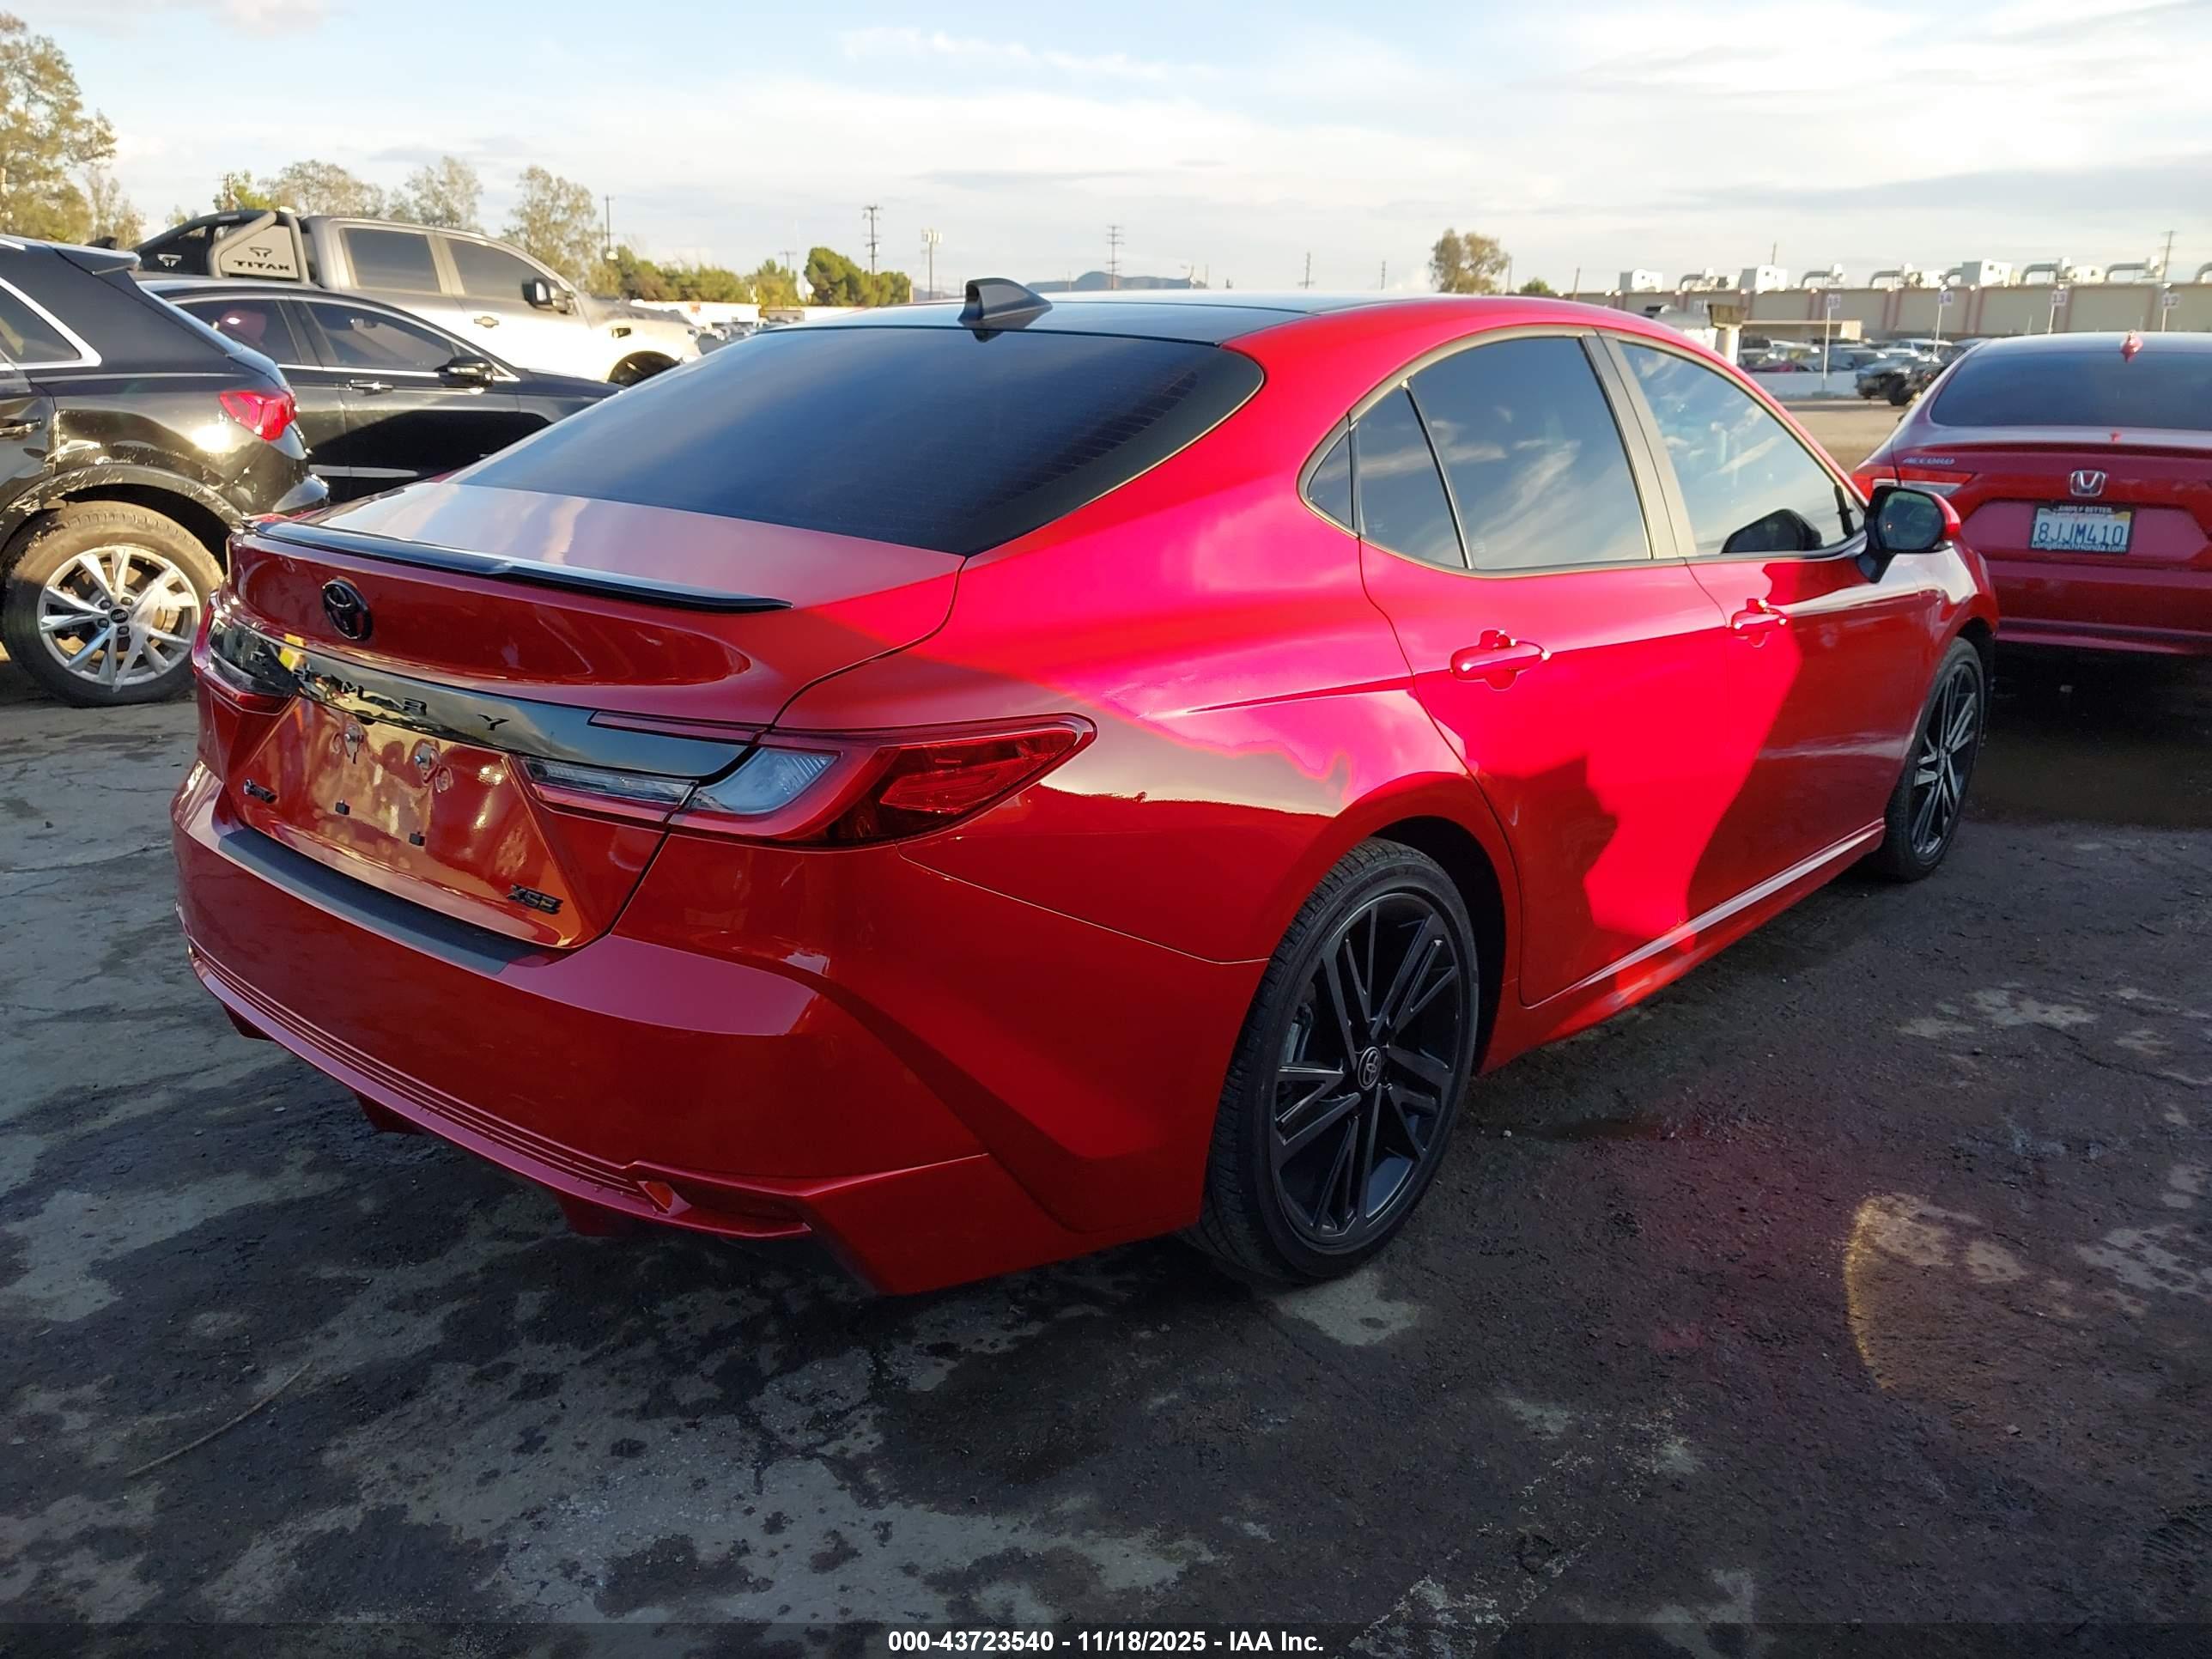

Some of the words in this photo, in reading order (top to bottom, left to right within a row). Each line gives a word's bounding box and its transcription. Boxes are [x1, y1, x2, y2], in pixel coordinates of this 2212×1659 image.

[234, 259, 290, 271] TITAN
[2038, 521, 2124, 546] 8JJM410
[507, 884, 563, 915] XSE
